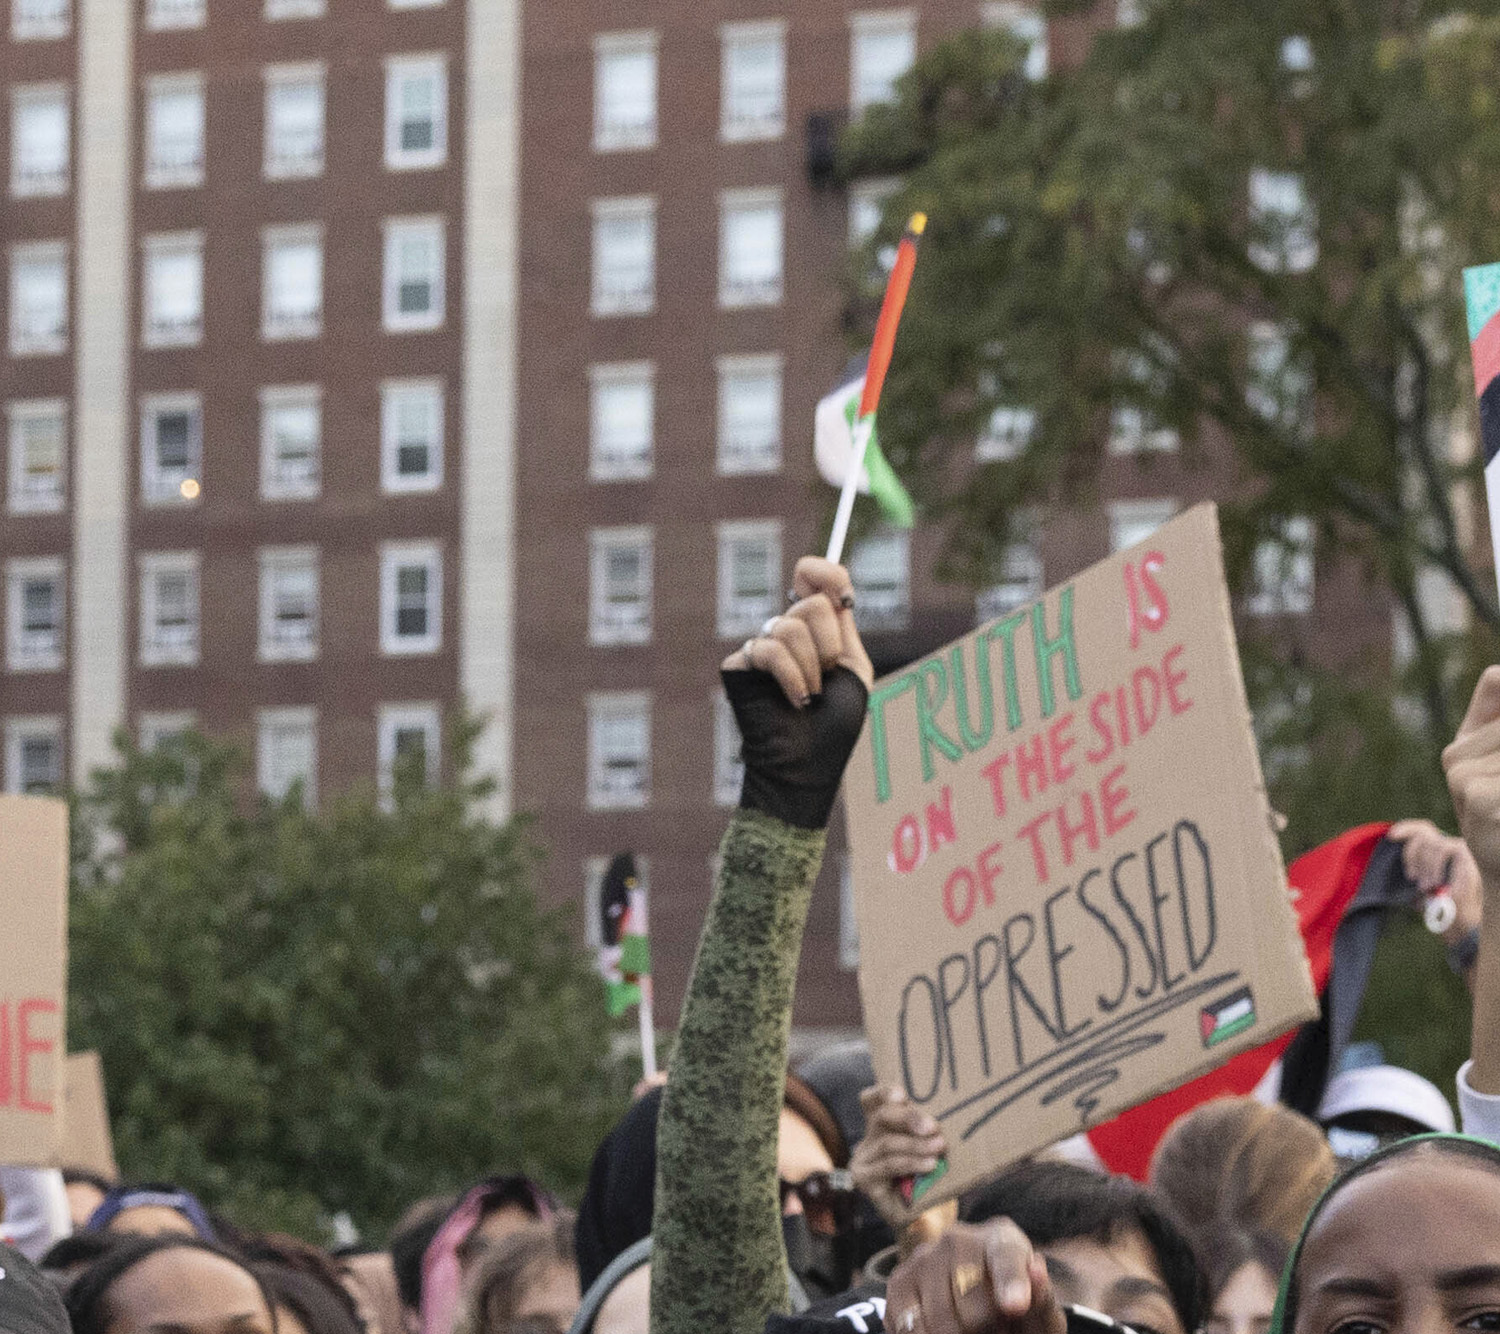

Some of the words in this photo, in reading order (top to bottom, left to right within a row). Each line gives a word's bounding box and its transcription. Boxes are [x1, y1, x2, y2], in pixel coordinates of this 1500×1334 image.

[867, 587, 1083, 802] TRUTH
[1124, 550, 1169, 648] IS
[888, 786, 958, 873] ON
[980, 713, 1078, 816] THE
[1087, 644, 1195, 765] SIDE
[899, 819, 1218, 1104] OPPRESSED
[943, 844, 1003, 927] OF
[1017, 765, 1139, 884] THE
